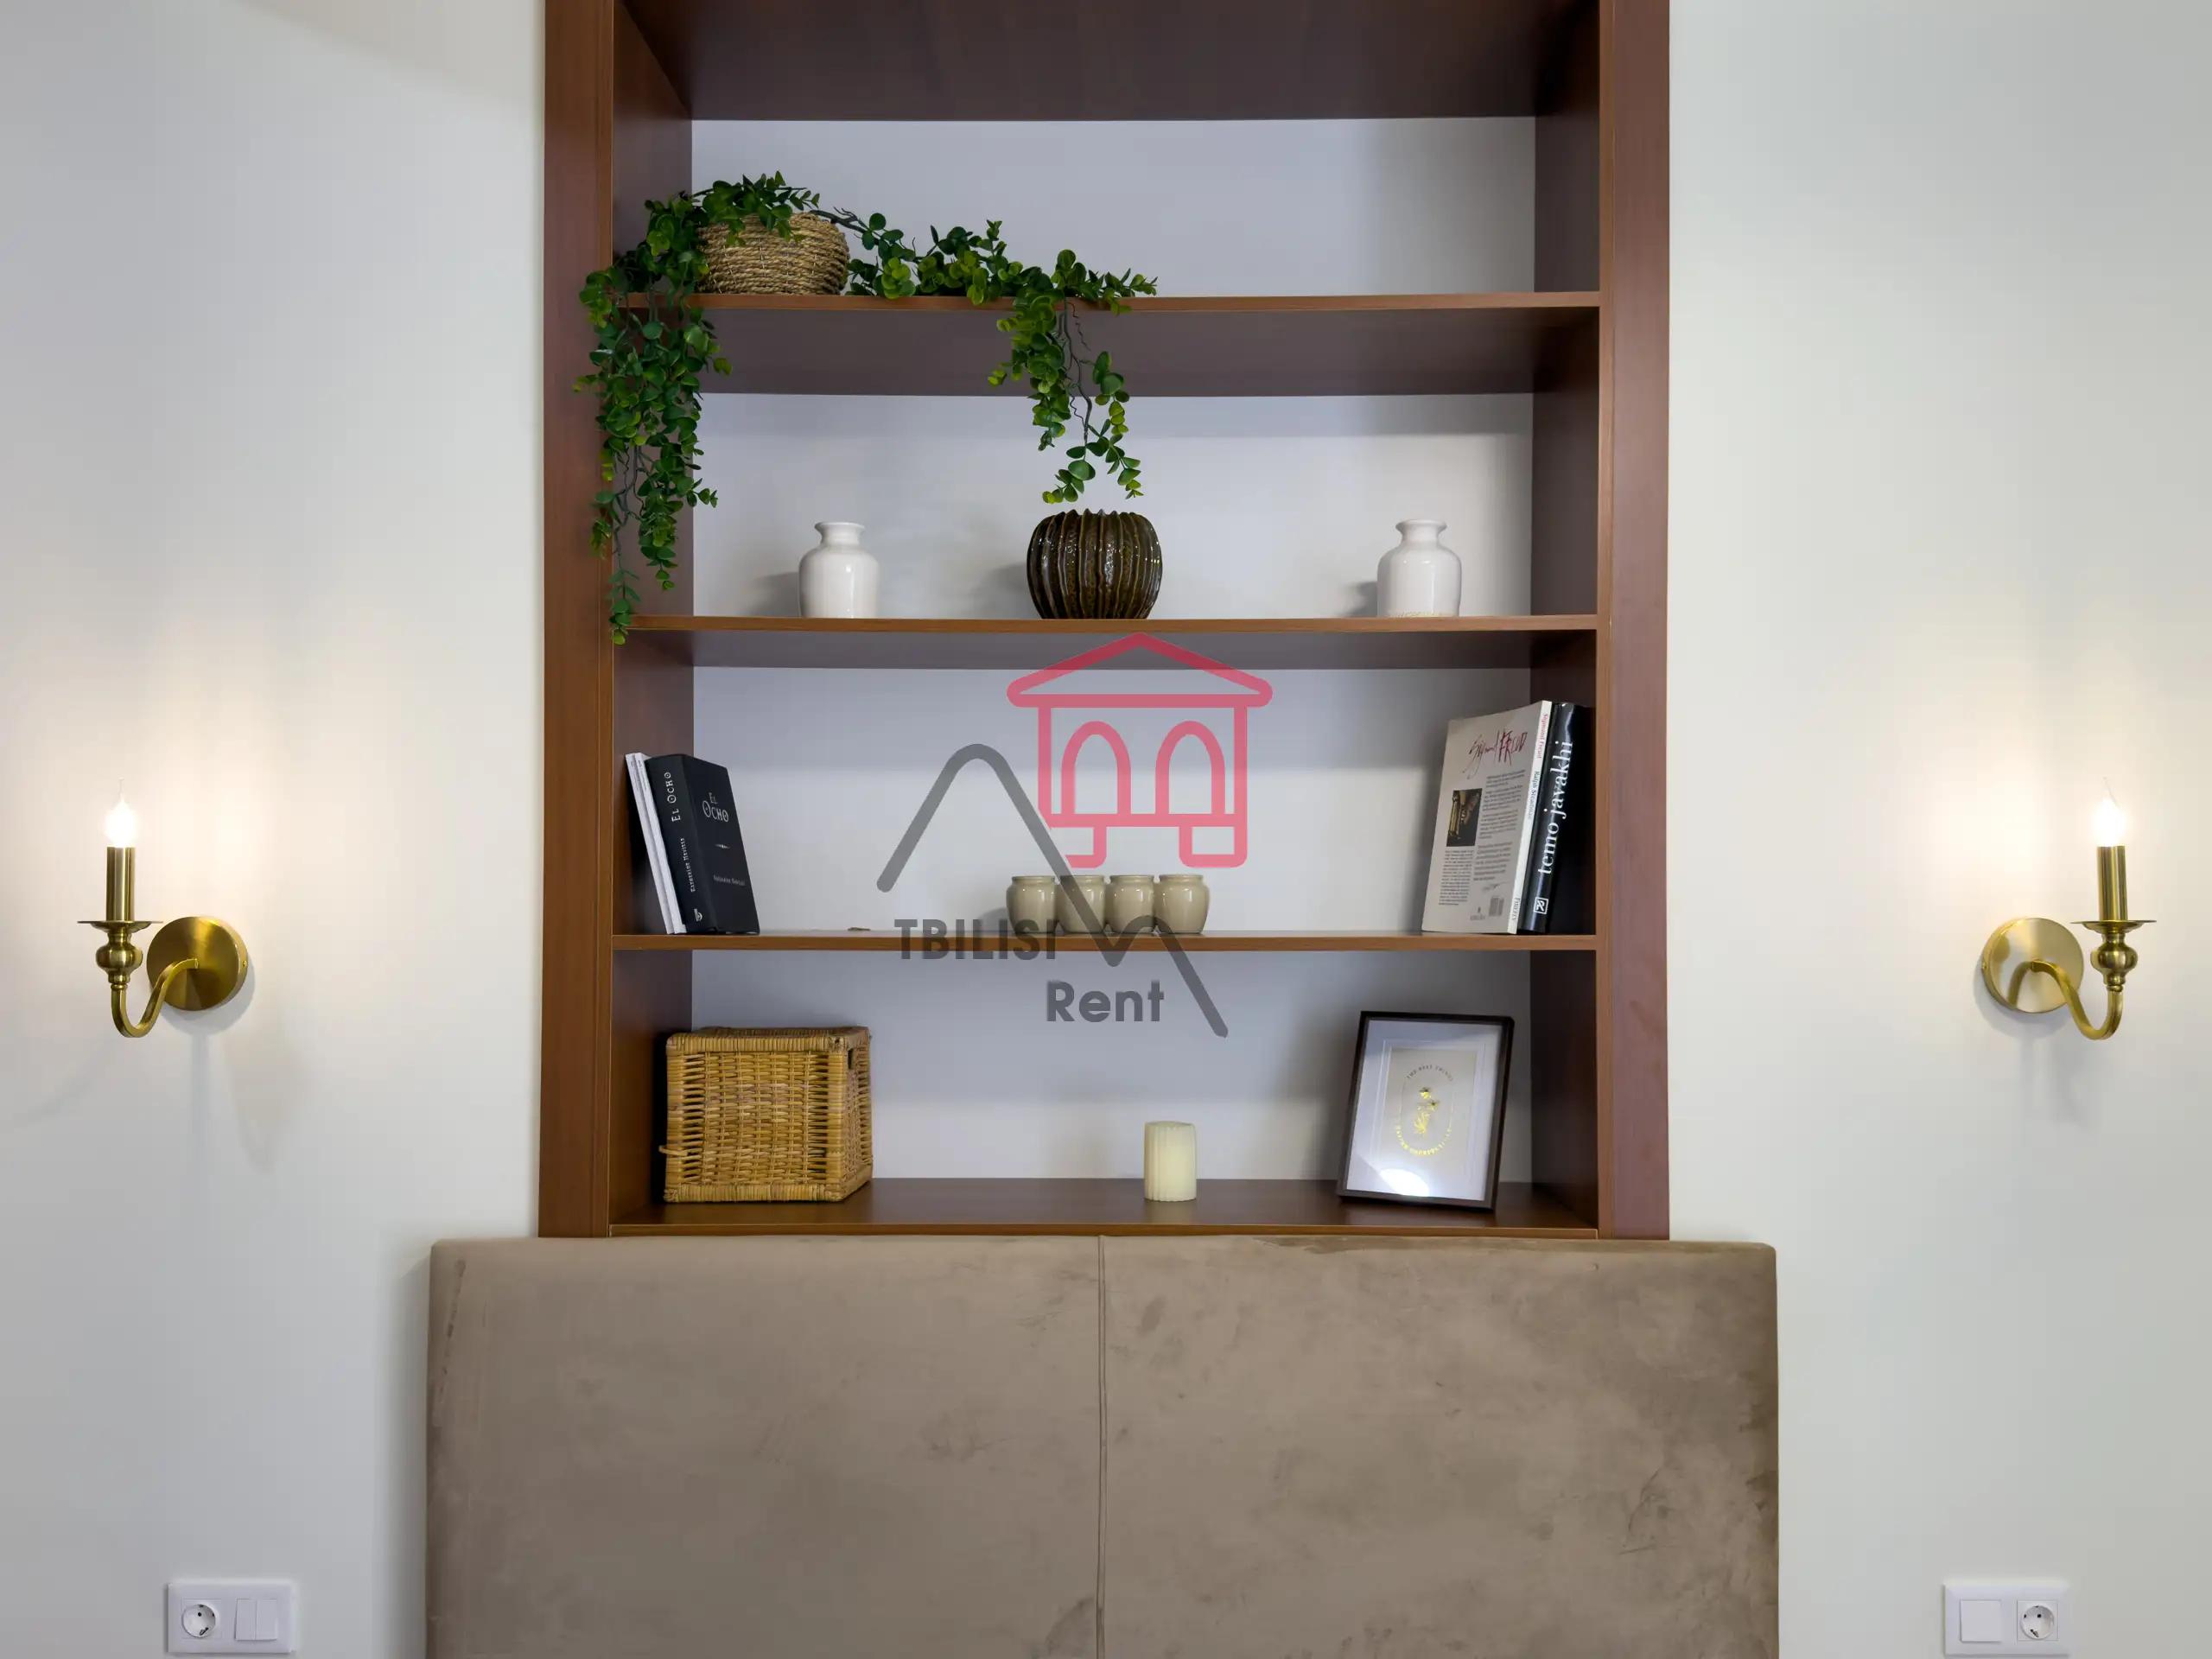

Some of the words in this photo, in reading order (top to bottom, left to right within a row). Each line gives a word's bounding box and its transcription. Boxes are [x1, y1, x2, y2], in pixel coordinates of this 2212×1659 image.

[664, 772, 677, 804] OCHO
[1543, 741, 1573, 819] javakhi
[702, 799, 730, 823] OCHO
[709, 791, 718, 805] EL
[671, 808, 682, 823] EL
[1538, 822, 1559, 875] temo
